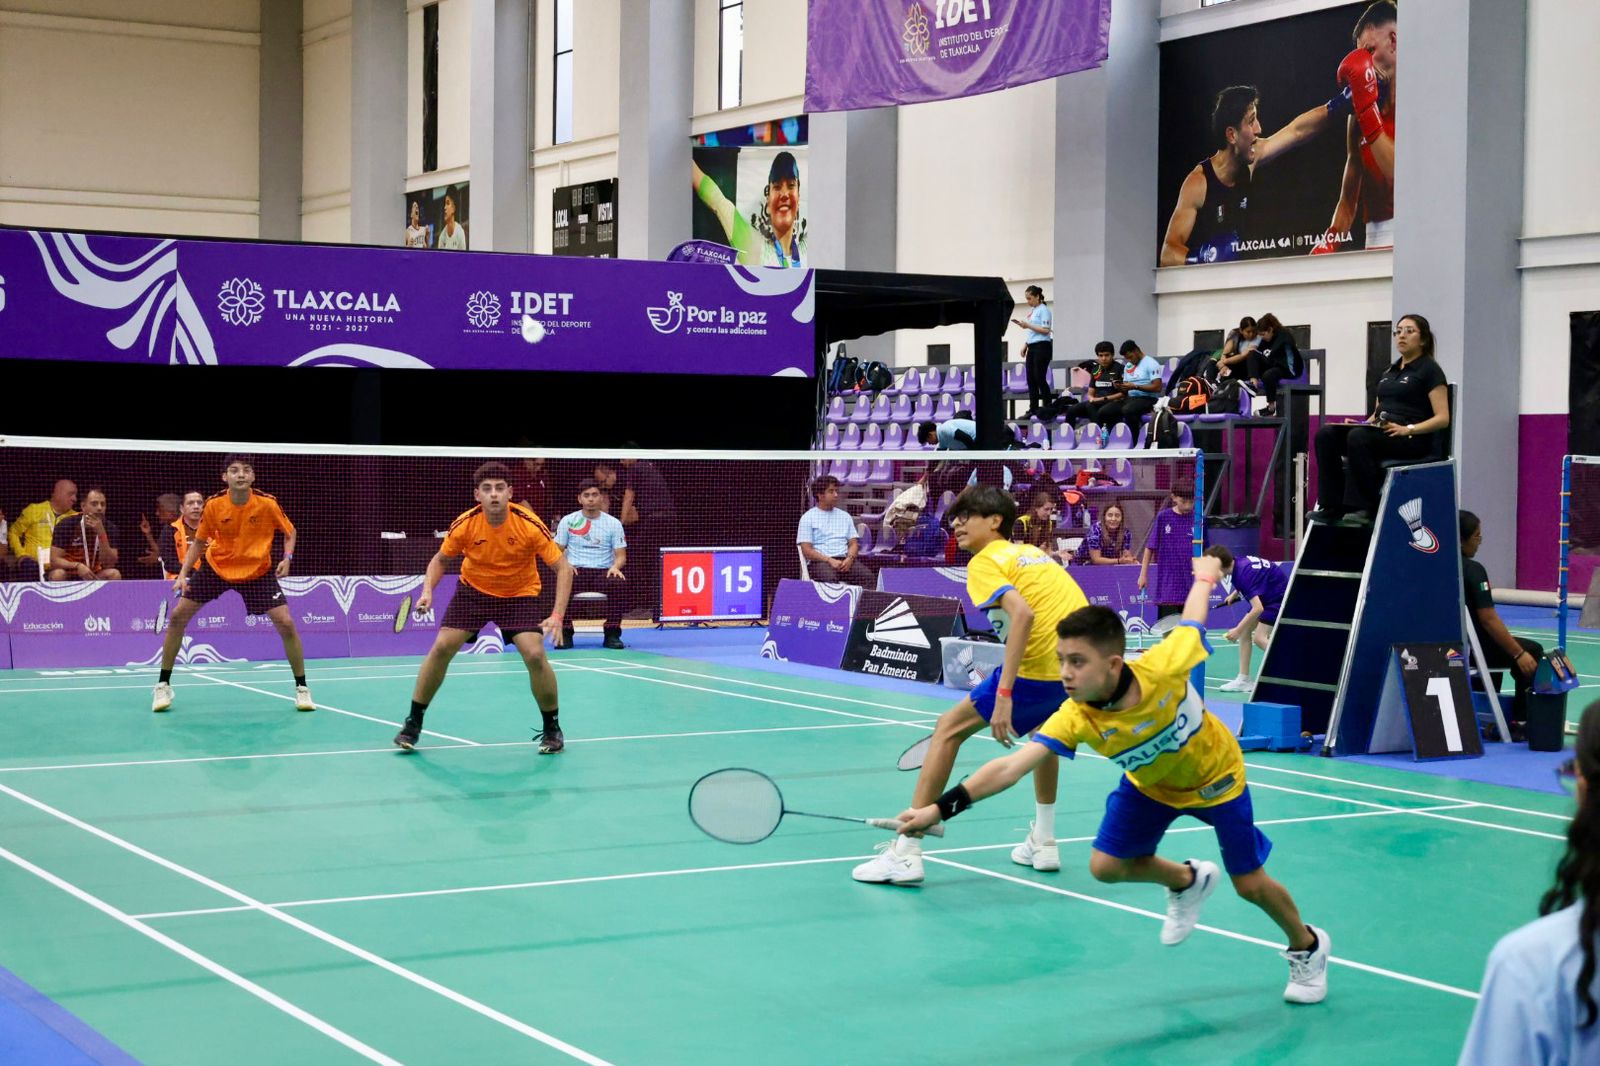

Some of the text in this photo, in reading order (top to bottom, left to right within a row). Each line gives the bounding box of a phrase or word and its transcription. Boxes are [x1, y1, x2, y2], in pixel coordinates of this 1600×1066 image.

[939, 33, 969, 47] INSTITUTO
[970, 31, 983, 41] DEL
[940, 44, 980, 59] DE TLAXCALA
[555, 209, 568, 228] LOCAL
[1231, 239, 1276, 252] TLAXCALA
[1304, 232, 1353, 246] TLAXCALA
[697, 247, 730, 262] TLAXCALA
[273, 289, 401, 312] TLAXCALA
[510, 291, 574, 315] IDET
[285, 313, 394, 324] UNA NUEVA HISTORIA
[687, 305, 767, 328] Por la paz
[309, 323, 332, 331] 2021
[345, 324, 369, 332] 2027
[547, 320, 560, 328] DEL
[561, 320, 591, 329] DEPORTE
[686, 326, 767, 336] y contra las adicciones
[671, 565, 753, 594] 10 15
[84, 616, 111, 632] ON
[358, 613, 394, 621] Educación
[23, 621, 64, 630] Educación
[870, 644, 918, 663] Badminton
[862, 660, 917, 680] Pan America
[1426, 677, 1463, 751] 1
